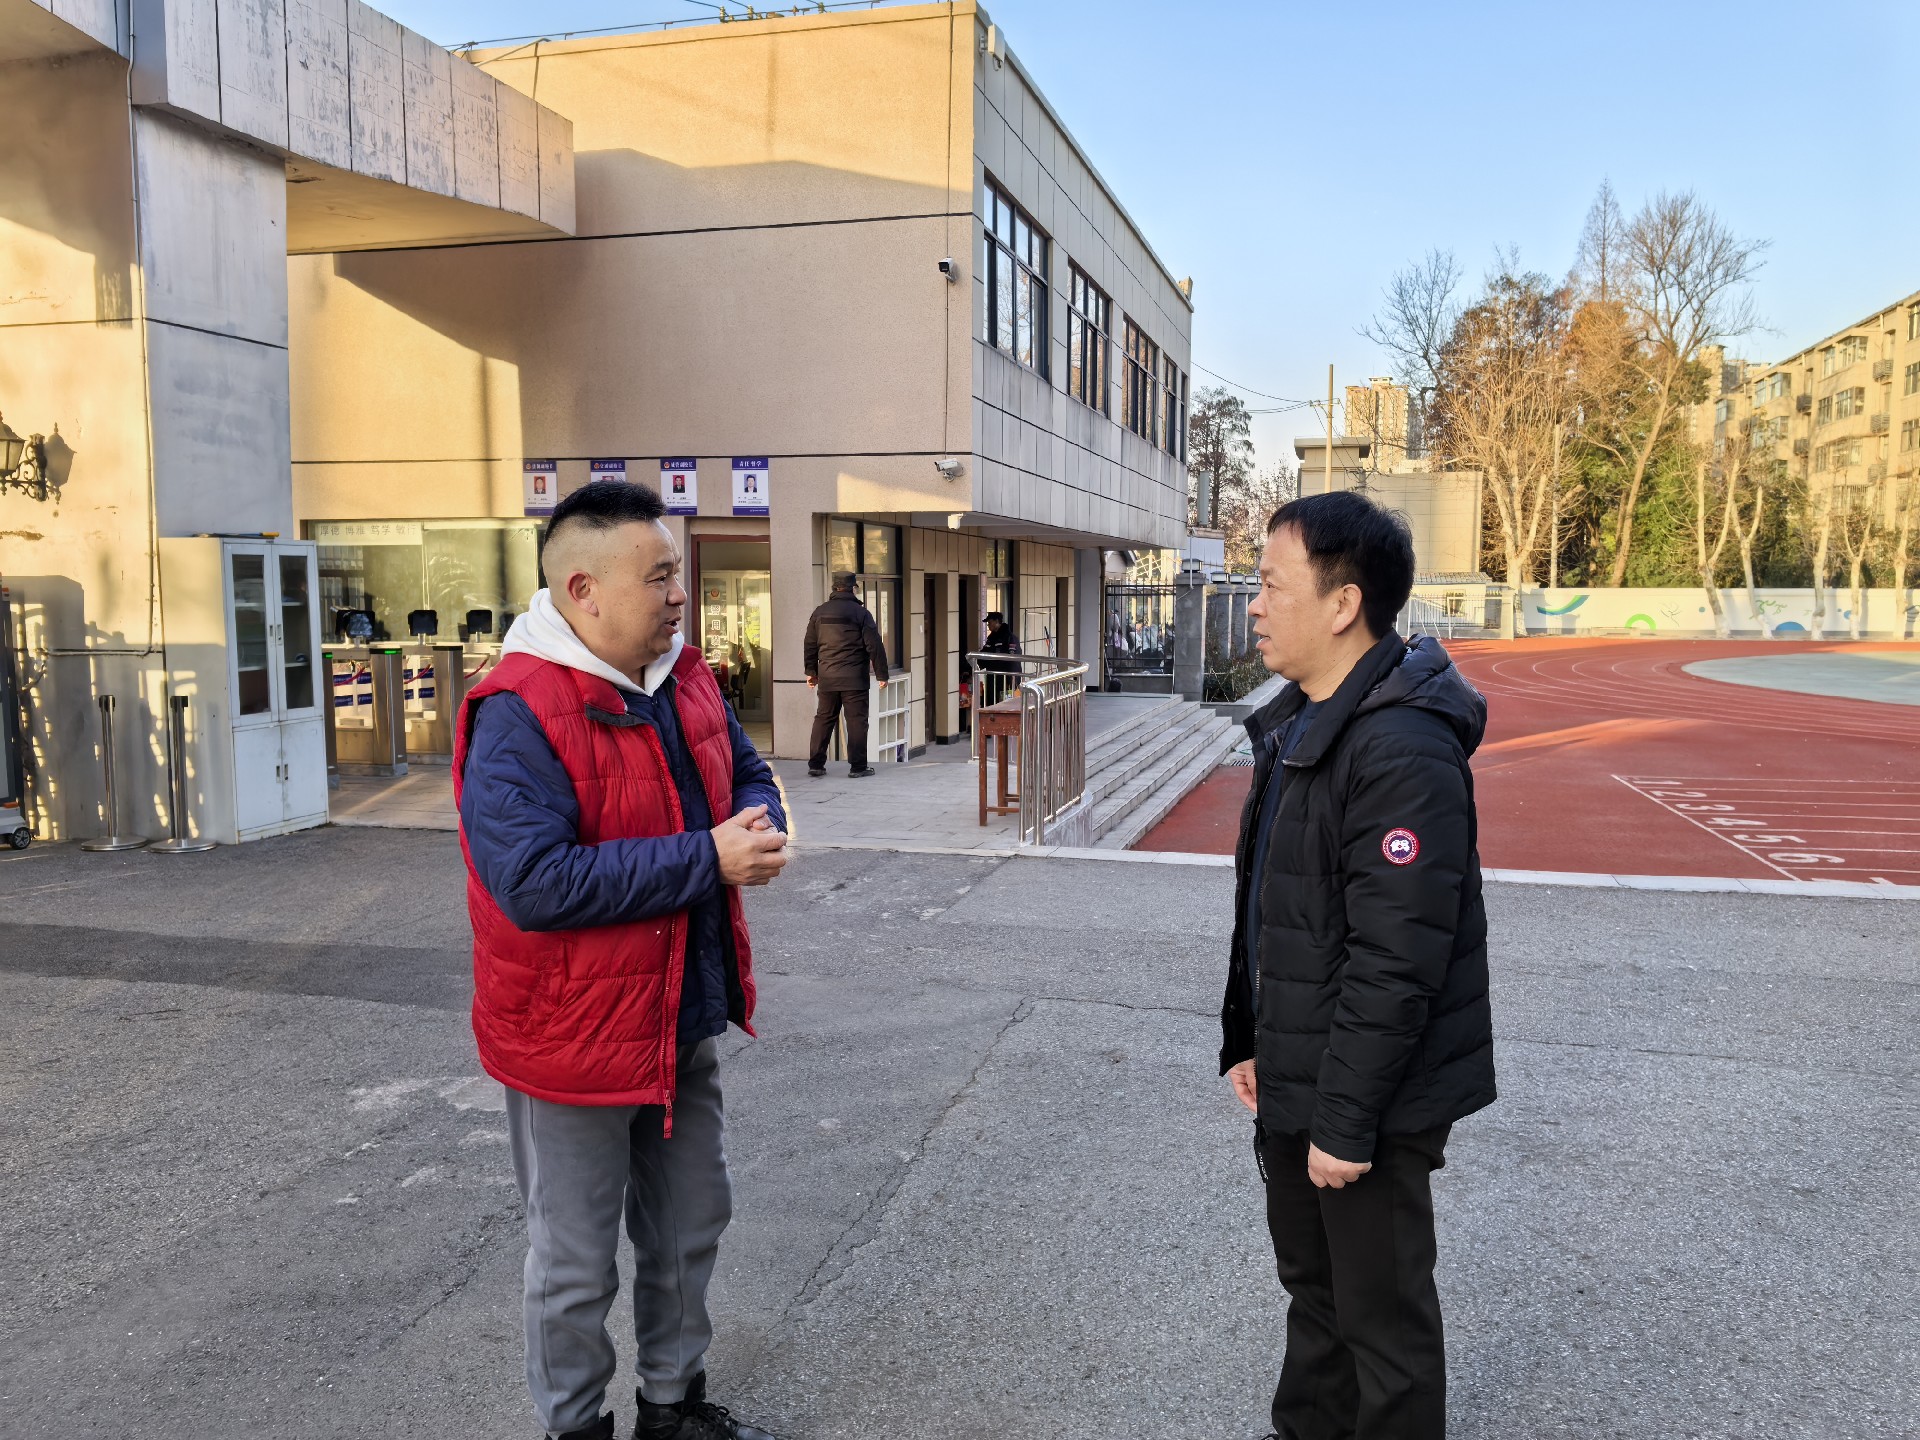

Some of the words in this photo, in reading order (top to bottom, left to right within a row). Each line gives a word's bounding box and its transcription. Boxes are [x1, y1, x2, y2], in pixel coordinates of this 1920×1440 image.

[320, 525, 340, 536] 厚德
[345, 525, 365, 536] 博雅
[371, 524, 391, 536] 笃学
[1649, 790, 1707, 798] 2
[1674, 803, 1735, 811] 3
[1706, 817, 1768, 826] 4
[1733, 834, 1807, 843] 5
[1768, 852, 1846, 863] 6
